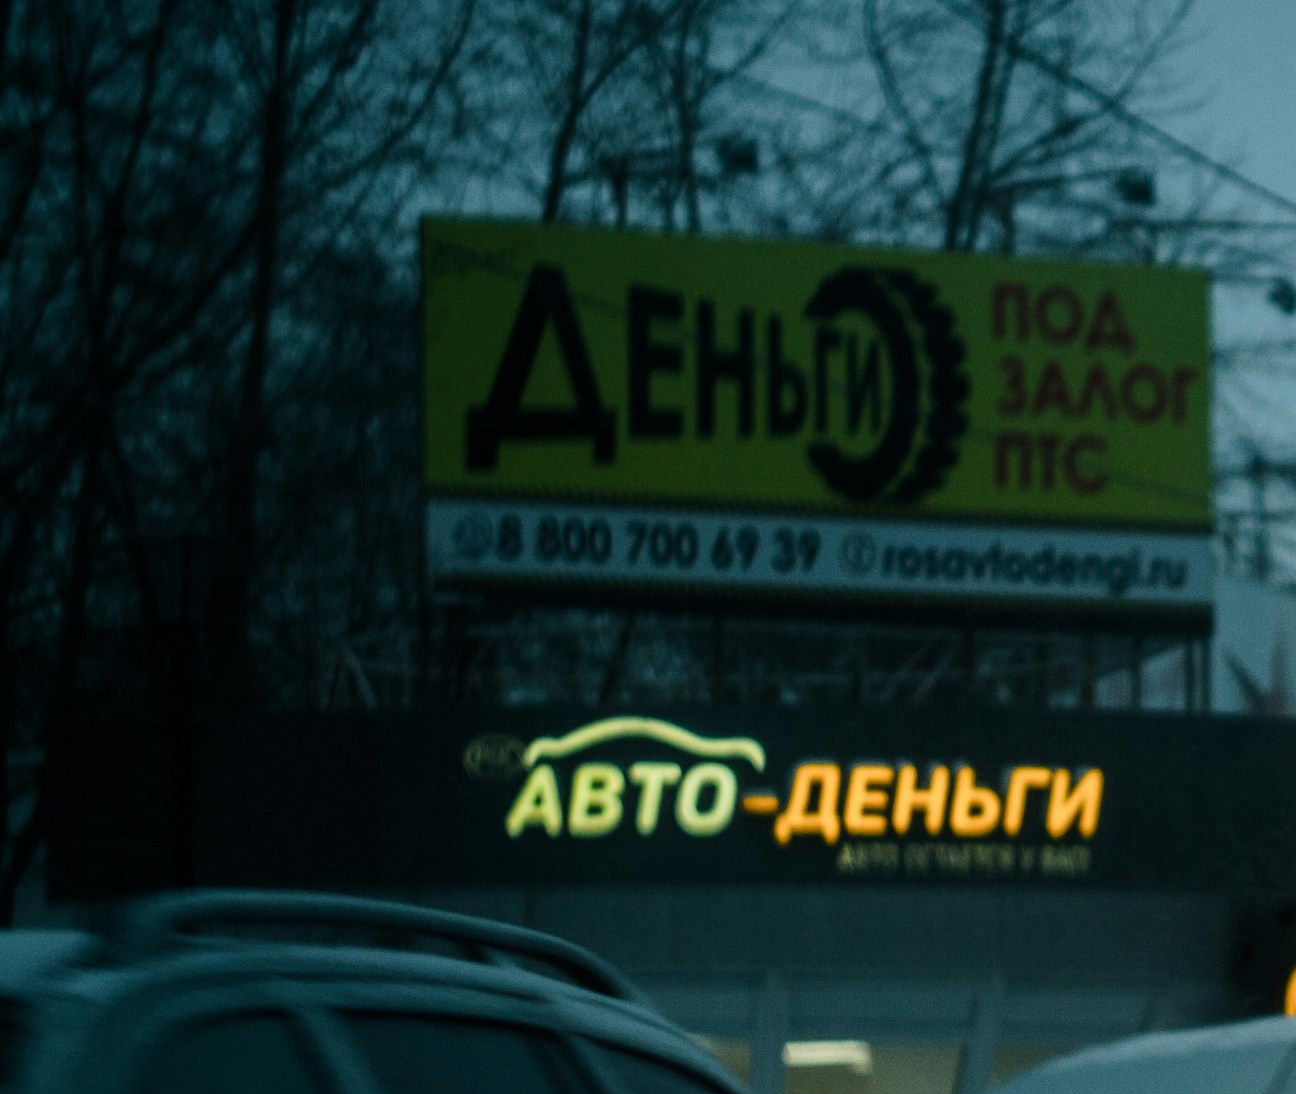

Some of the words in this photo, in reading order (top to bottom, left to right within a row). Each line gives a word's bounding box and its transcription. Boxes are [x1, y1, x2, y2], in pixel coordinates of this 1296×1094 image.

[994, 281, 1134, 352] ПОД
[998, 357, 1194, 425] ЗАЛОГ
[996, 432, 1110, 494] ПТС
[498, 515, 522, 561] 8
[535, 516, 612, 564] 800
[625, 519, 698, 570] 700
[711, 525, 759, 571] 69
[771, 527, 820, 572] 39
[882, 540, 1187, 594] rosavtodengi.ru
[505, 760, 1104, 846] АВТО-ДЕНЬГИ
